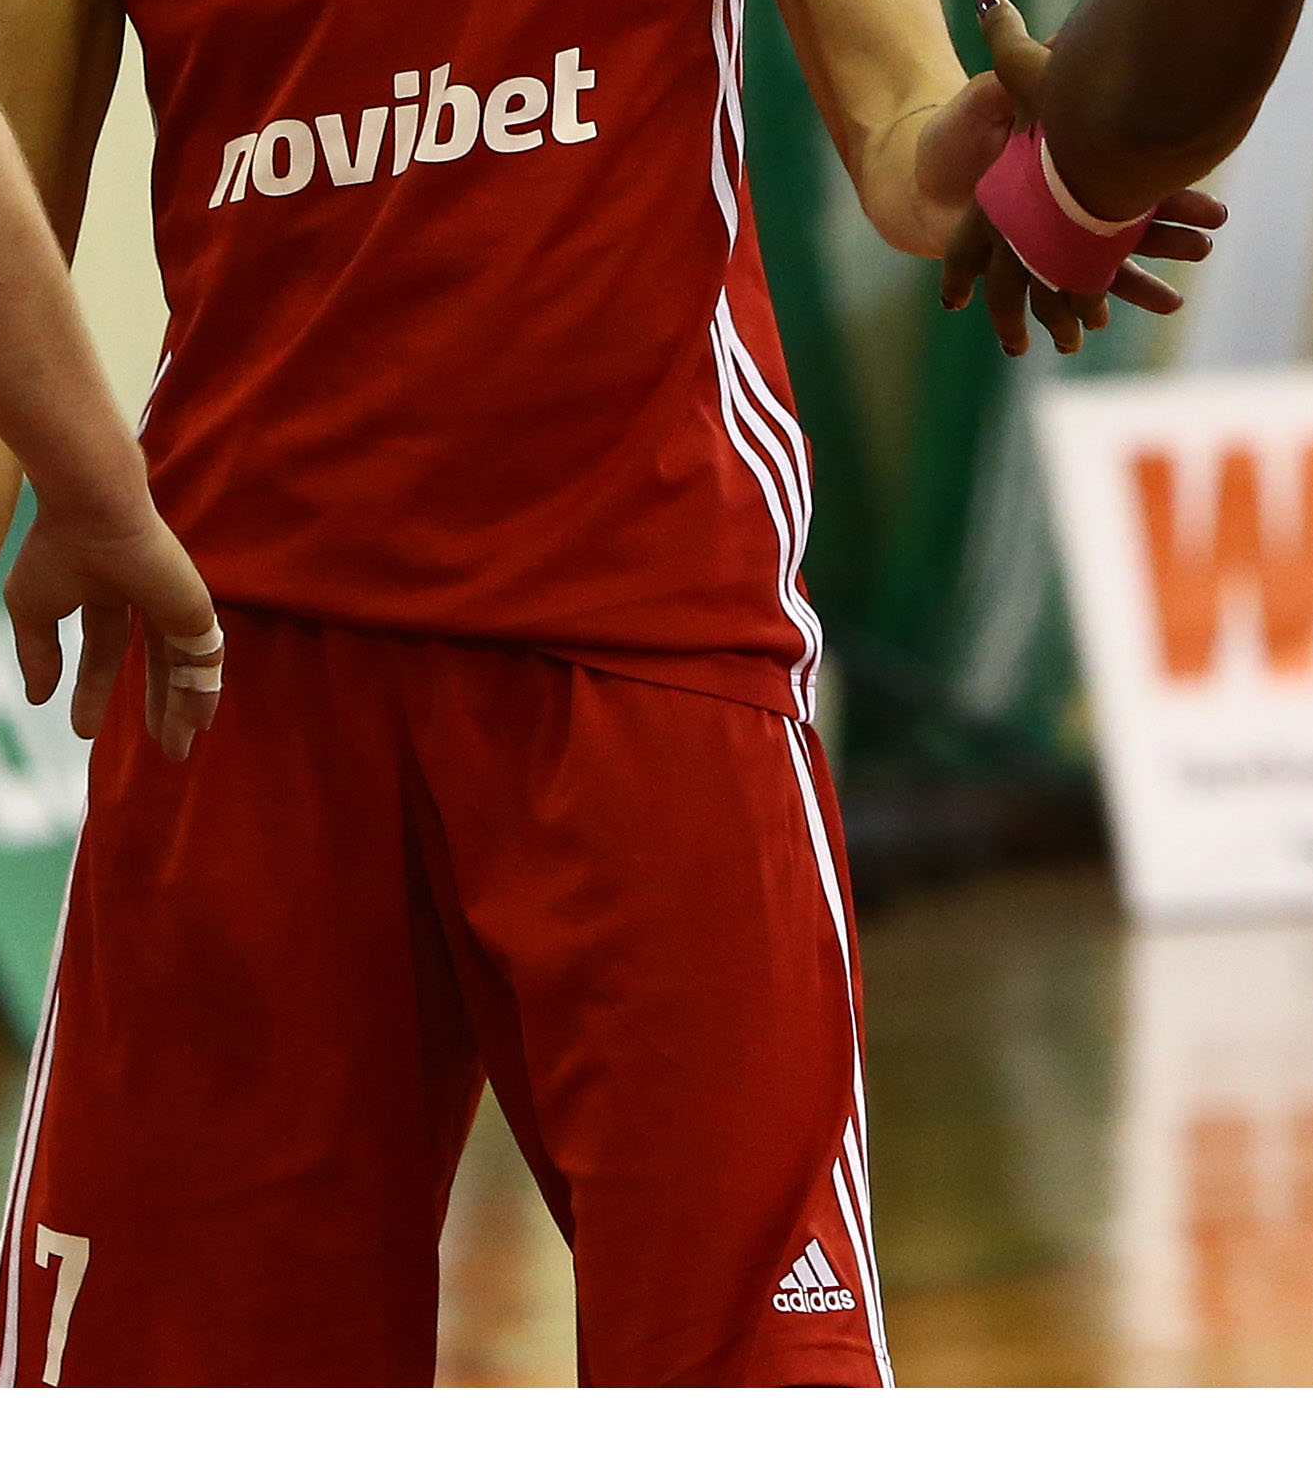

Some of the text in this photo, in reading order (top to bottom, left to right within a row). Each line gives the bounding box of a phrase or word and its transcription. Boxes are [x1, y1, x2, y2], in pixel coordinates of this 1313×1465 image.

[208, 47, 597, 209] novibet
[34, 1222, 89, 1387] 7
[773, 1286, 856, 1314] adidas
